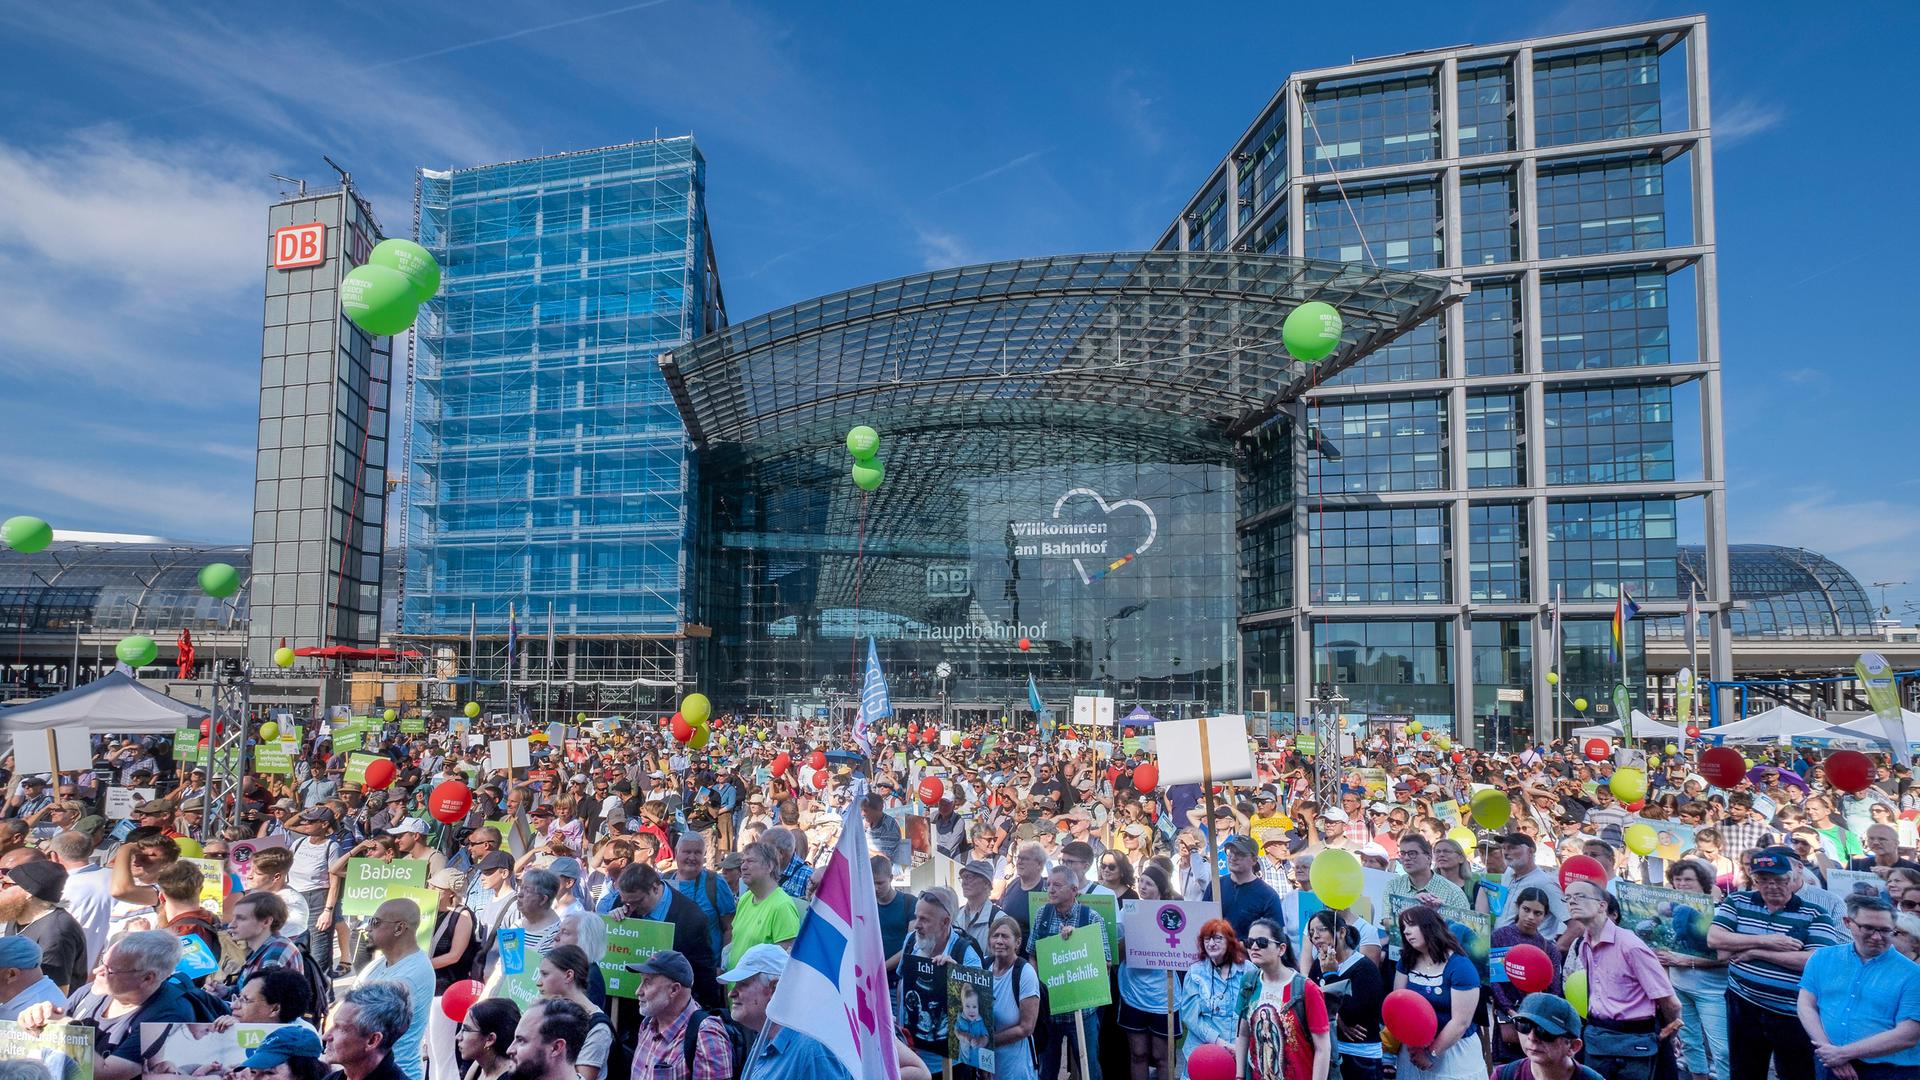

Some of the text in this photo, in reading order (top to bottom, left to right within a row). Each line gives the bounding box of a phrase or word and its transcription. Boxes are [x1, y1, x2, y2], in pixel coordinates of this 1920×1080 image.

[280, 230, 318, 262] DB
[1011, 521, 1108, 537] Willkommen
[1014, 540, 1108, 556] am Bahnhof
[931, 569, 966, 591] DB
[918, 621, 1048, 643] Hauptbahnhof
[359, 863, 413, 880] Babies
[347, 885, 388, 899] welc
[1685, 893, 1710, 905] kennt
[1461, 912, 1486, 925] kennt
[606, 923, 640, 938] Leben
[1051, 943, 1089, 966] Beistand
[1129, 948, 1181, 958] Frauenrechte
[917, 961, 934, 975] Ich!
[1145, 959, 1157, 967] im
[951, 968, 990, 988] Auch ich!
[1047, 962, 1100, 988] statt Beihilfe
[57, 1031, 89, 1046] kennt
[244, 1031, 261, 1046] JA
[4, 1041, 26, 1056] Alter
